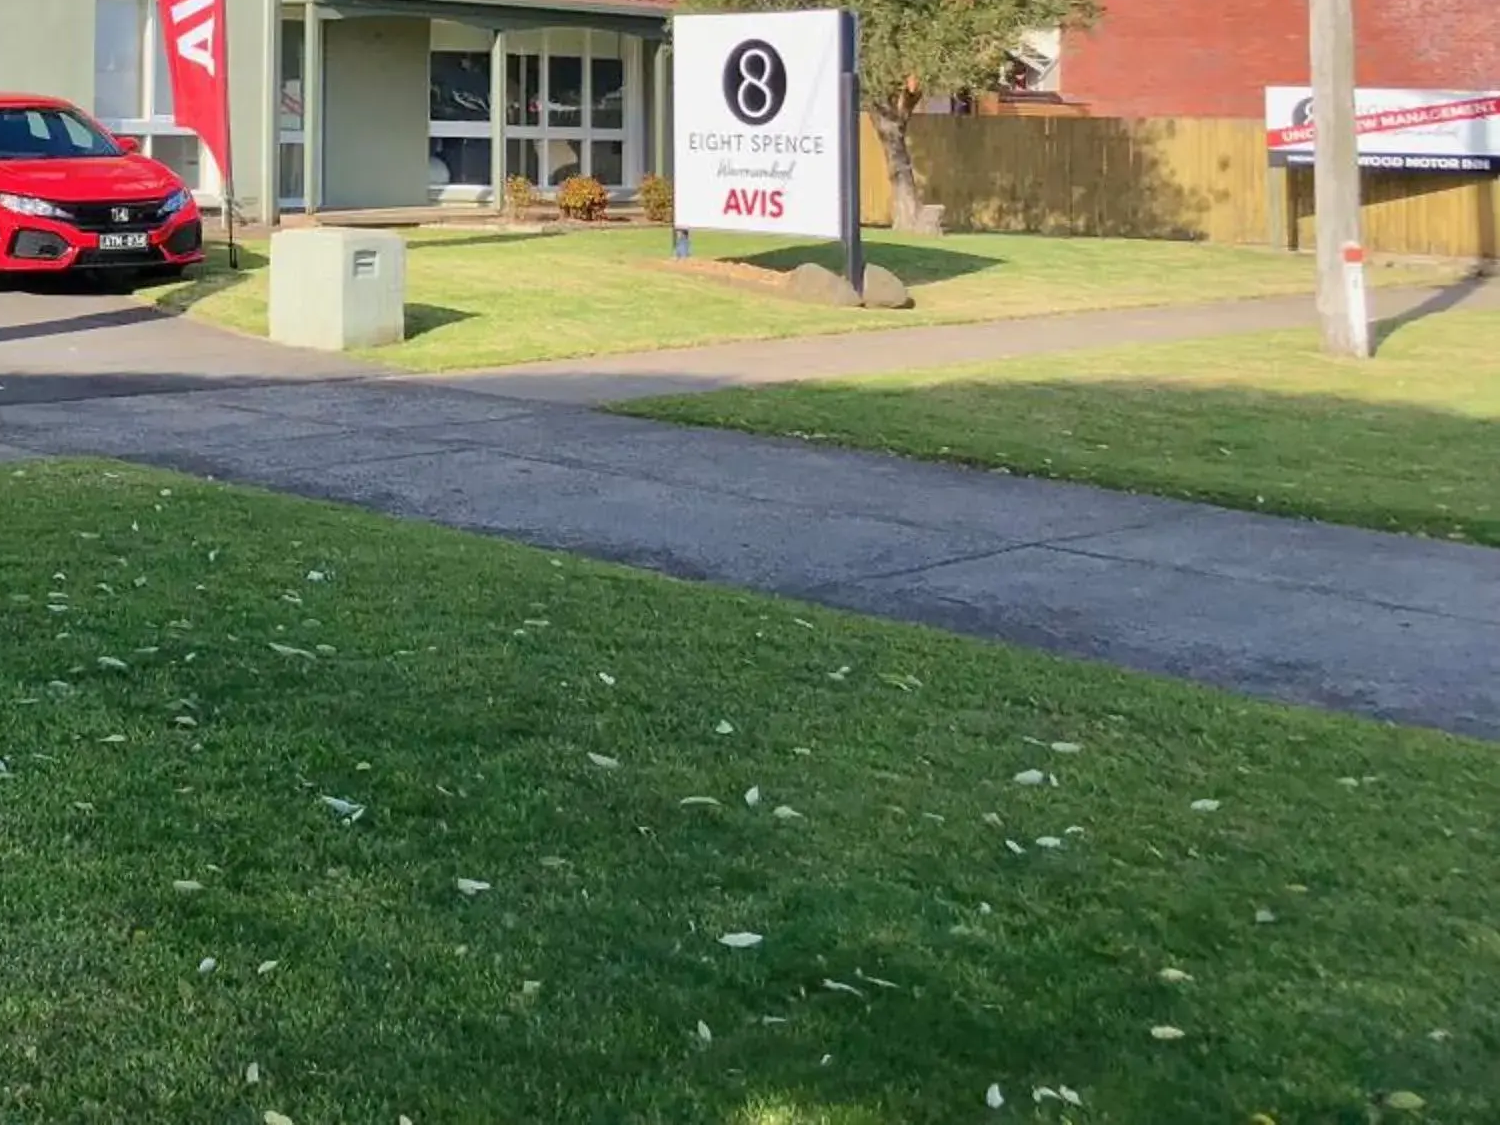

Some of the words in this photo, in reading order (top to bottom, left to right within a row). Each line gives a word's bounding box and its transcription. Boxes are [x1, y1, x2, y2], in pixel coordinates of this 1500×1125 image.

[737, 48, 772, 118] 8
[1380, 99, 1497, 128] MANAGEMENT
[688, 132, 744, 152] EIGHT
[750, 134, 824, 155] SPENCE
[1405, 156, 1459, 169] MOTOR
[722, 187, 785, 219] AVIS
